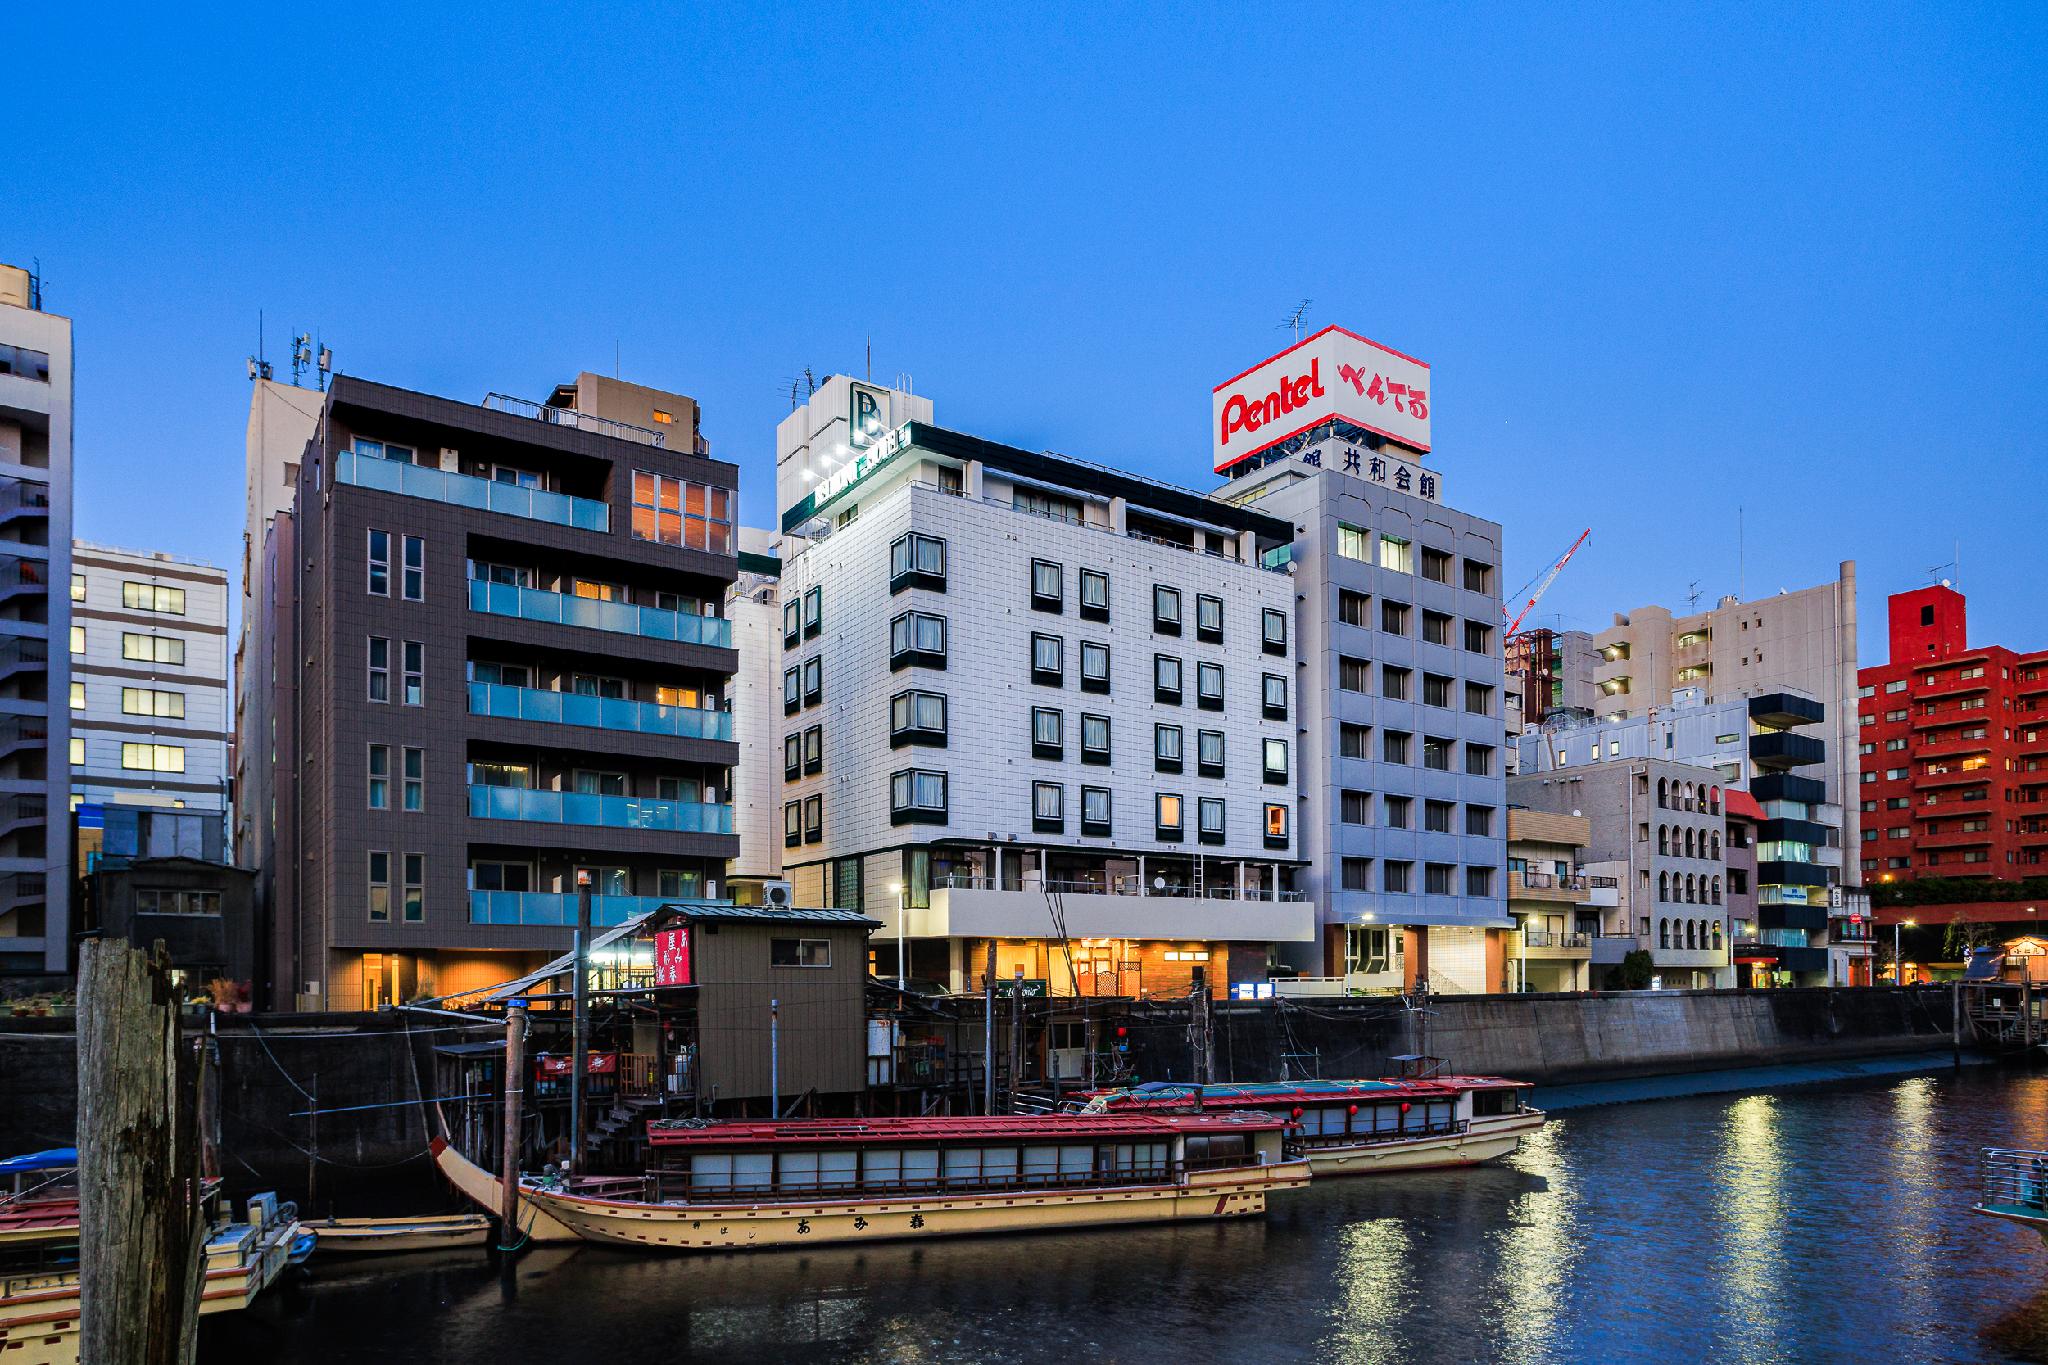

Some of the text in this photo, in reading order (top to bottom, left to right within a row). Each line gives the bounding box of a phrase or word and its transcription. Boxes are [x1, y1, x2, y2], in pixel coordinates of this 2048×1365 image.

[1221, 357, 1325, 446] Pentel
[1342, 446, 1436, 501] 共和会館
[797, 1213, 925, 1235] あみ春
